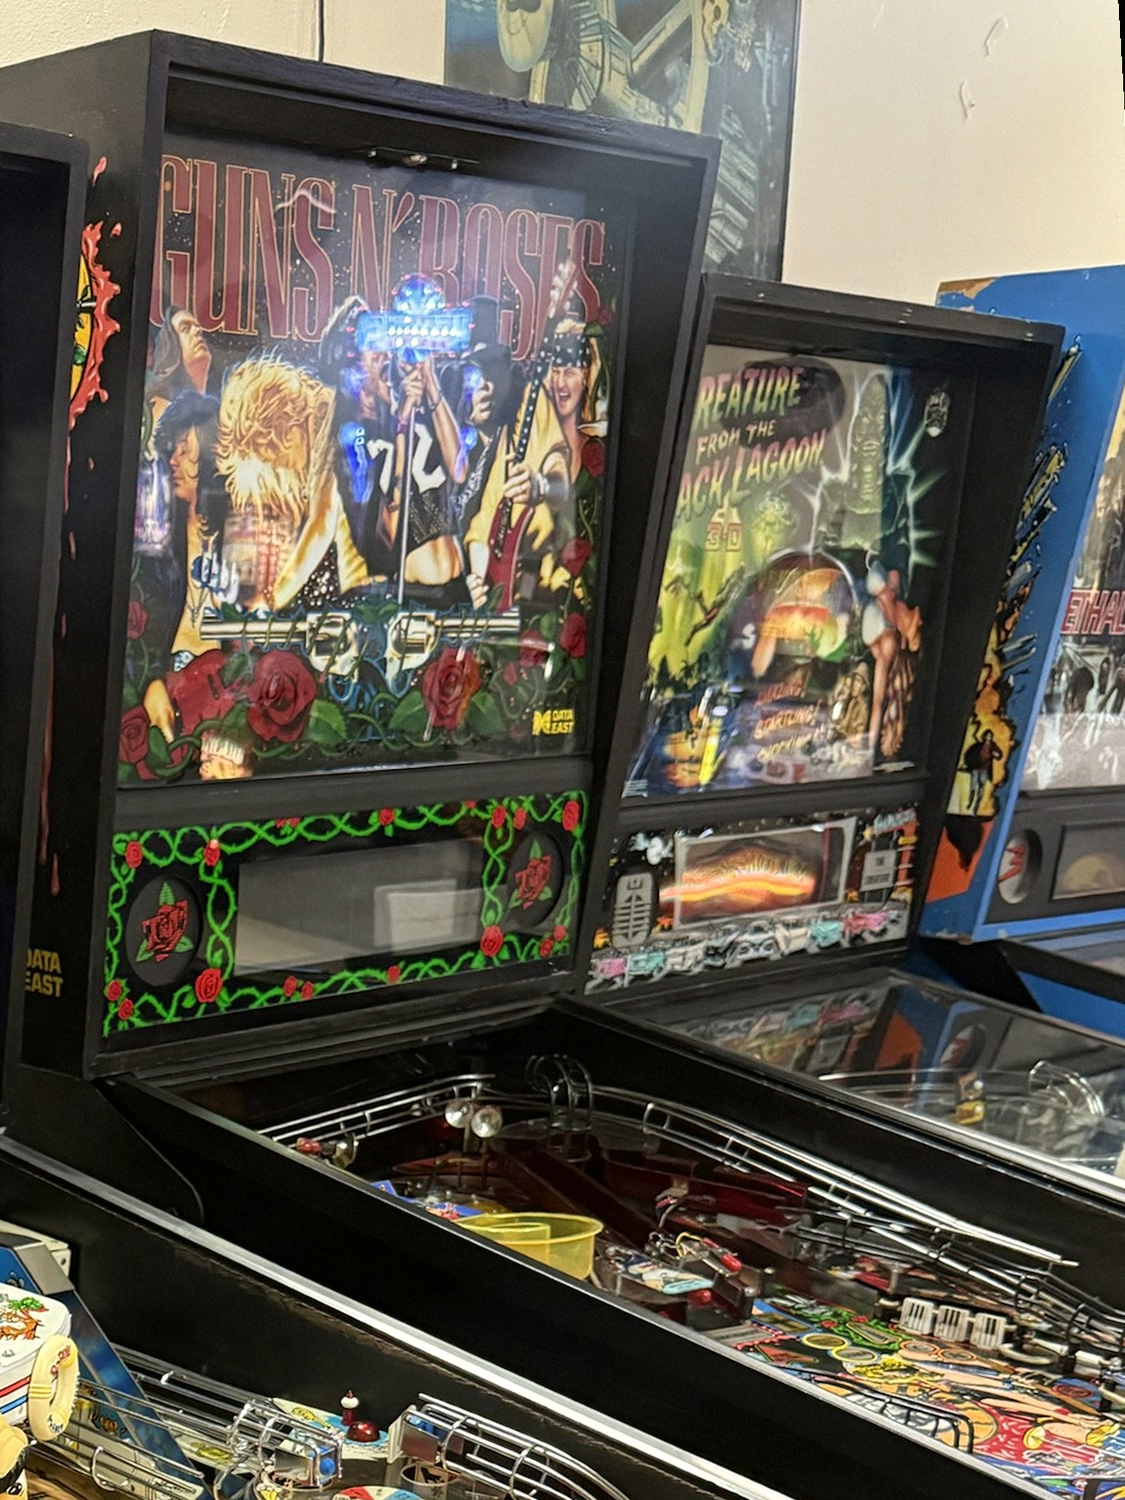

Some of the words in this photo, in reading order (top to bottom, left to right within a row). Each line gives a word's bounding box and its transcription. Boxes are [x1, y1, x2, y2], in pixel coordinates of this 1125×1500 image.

[149, 155, 335, 342] GUNS
[418, 194, 606, 361] ROSES
[693, 367, 805, 431] REATURE
[695, 428, 741, 465] FROM
[746, 419, 775, 444] THE
[676, 455, 730, 522] ACK
[730, 427, 828, 500] LAGOON
[1061, 589, 1125, 636] ETHAL
[551, 721, 575, 734] EAST
[552, 709, 573, 721] DATA
